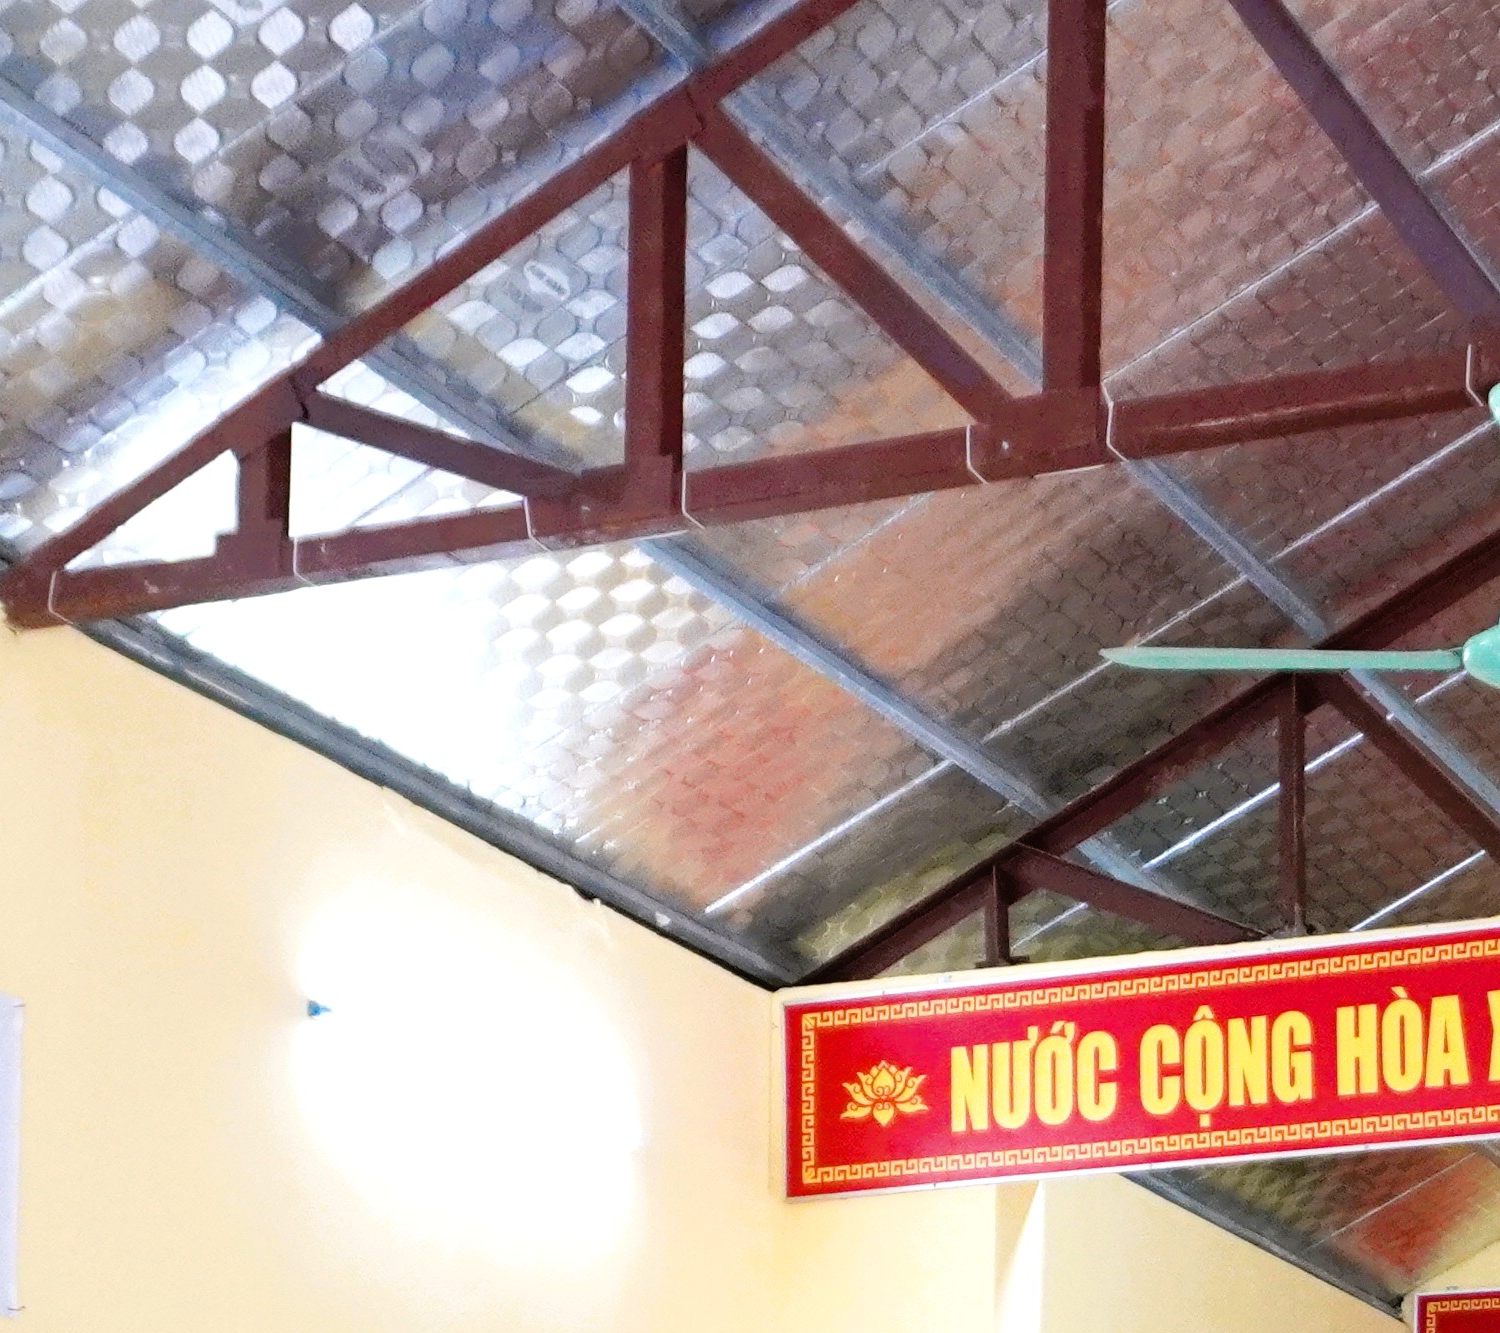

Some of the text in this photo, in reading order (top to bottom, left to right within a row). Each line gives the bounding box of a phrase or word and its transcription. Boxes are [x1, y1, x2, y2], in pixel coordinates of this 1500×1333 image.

[950, 1018, 1118, 1133] NƯỚC
[1138, 1004, 1313, 1128] CỘNG
[1336, 985, 1470, 1098] HÒA
